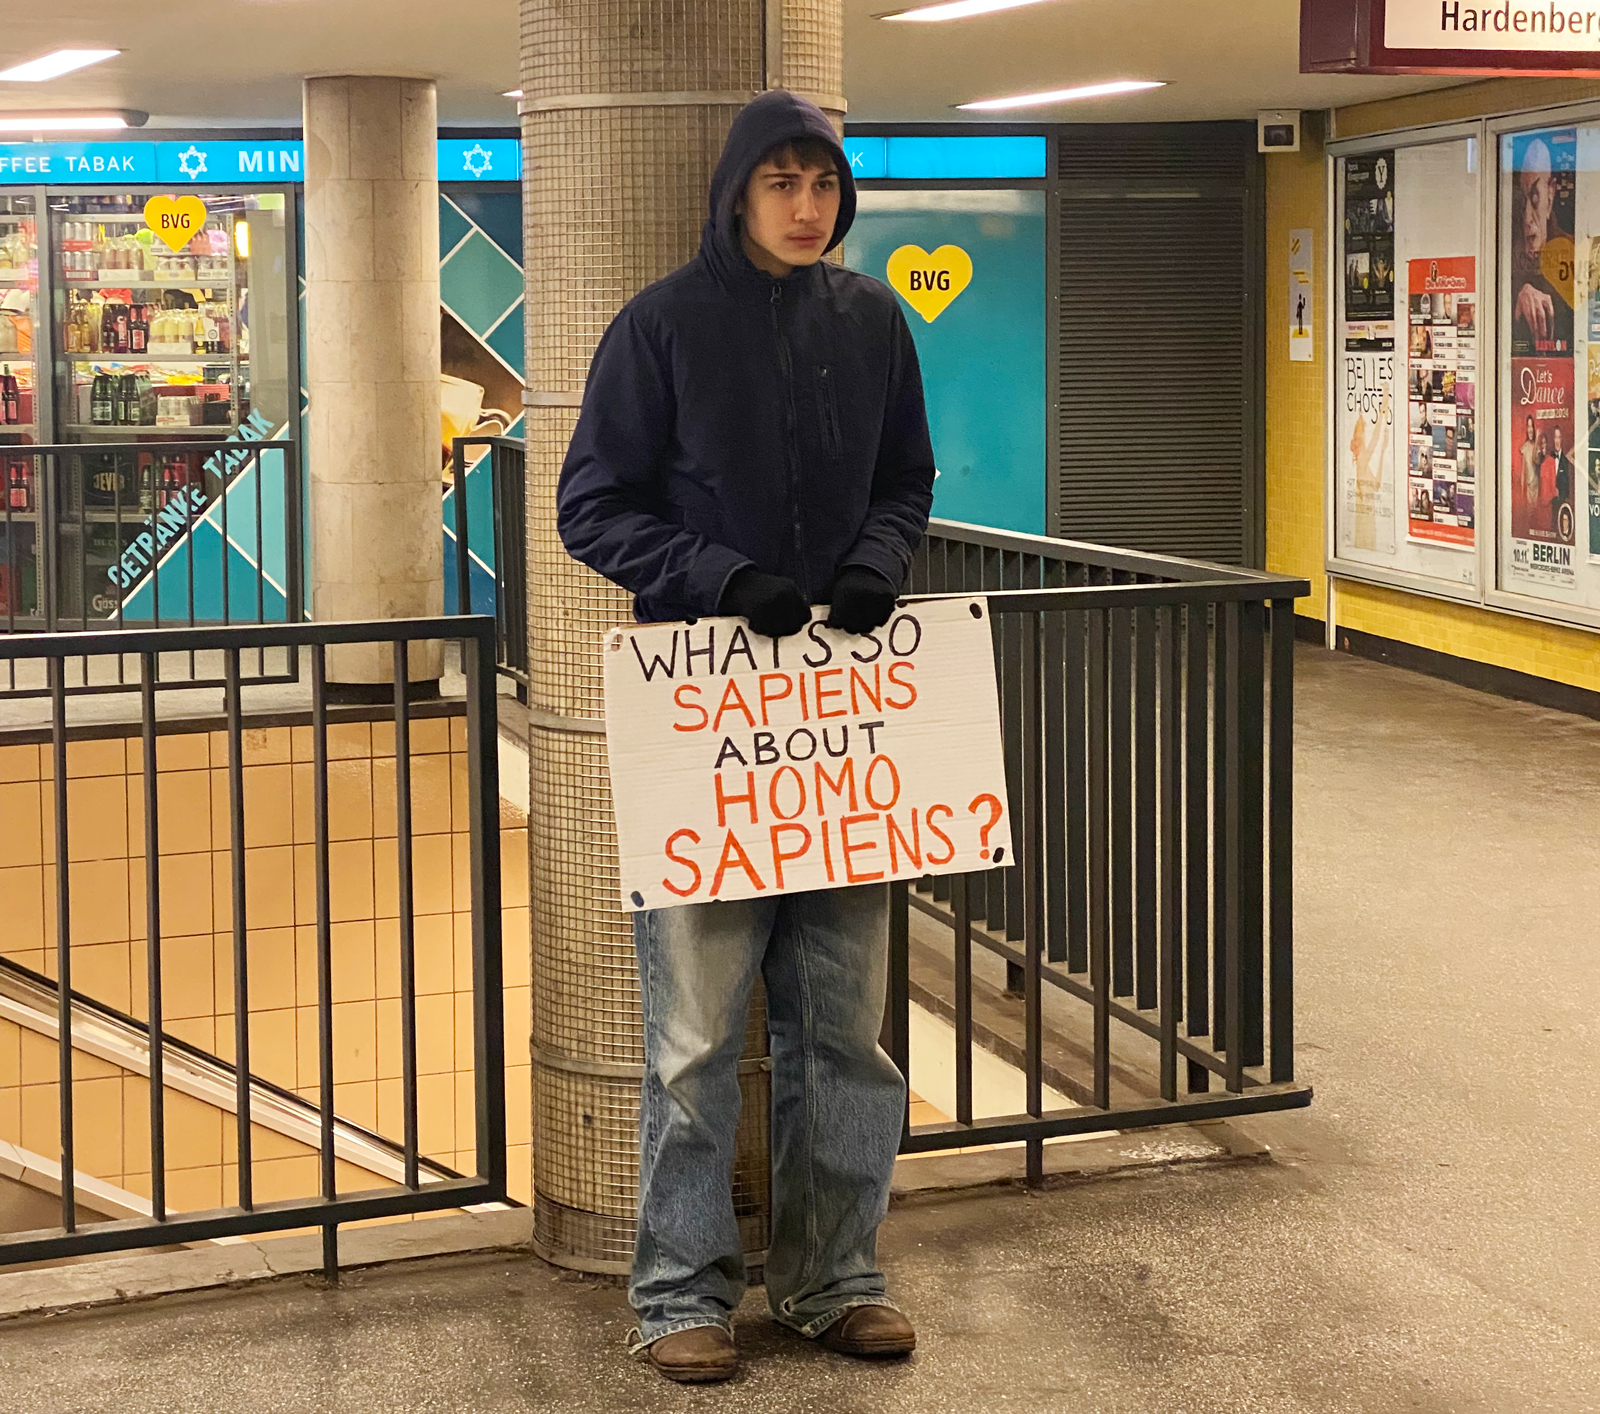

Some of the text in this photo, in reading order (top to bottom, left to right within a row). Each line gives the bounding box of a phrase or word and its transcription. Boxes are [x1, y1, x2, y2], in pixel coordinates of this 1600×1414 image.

[1440, 0, 1600, 42] Hardenber
[65, 155, 135, 172] TABAK
[160, 213, 191, 229] BVG
[909, 270, 951, 291] BVG
[1345, 357, 1394, 391] BELLES
[1520, 367, 1565, 405] Dance
[1536, 370, 1553, 384] Let's
[1532, 543, 1571, 566] BERLIN
[630, 619, 833, 682] WHAS
[672, 661, 917, 732] SAPIENS
[713, 720, 885, 769] ABOUT
[713, 753, 901, 828] HOMO
